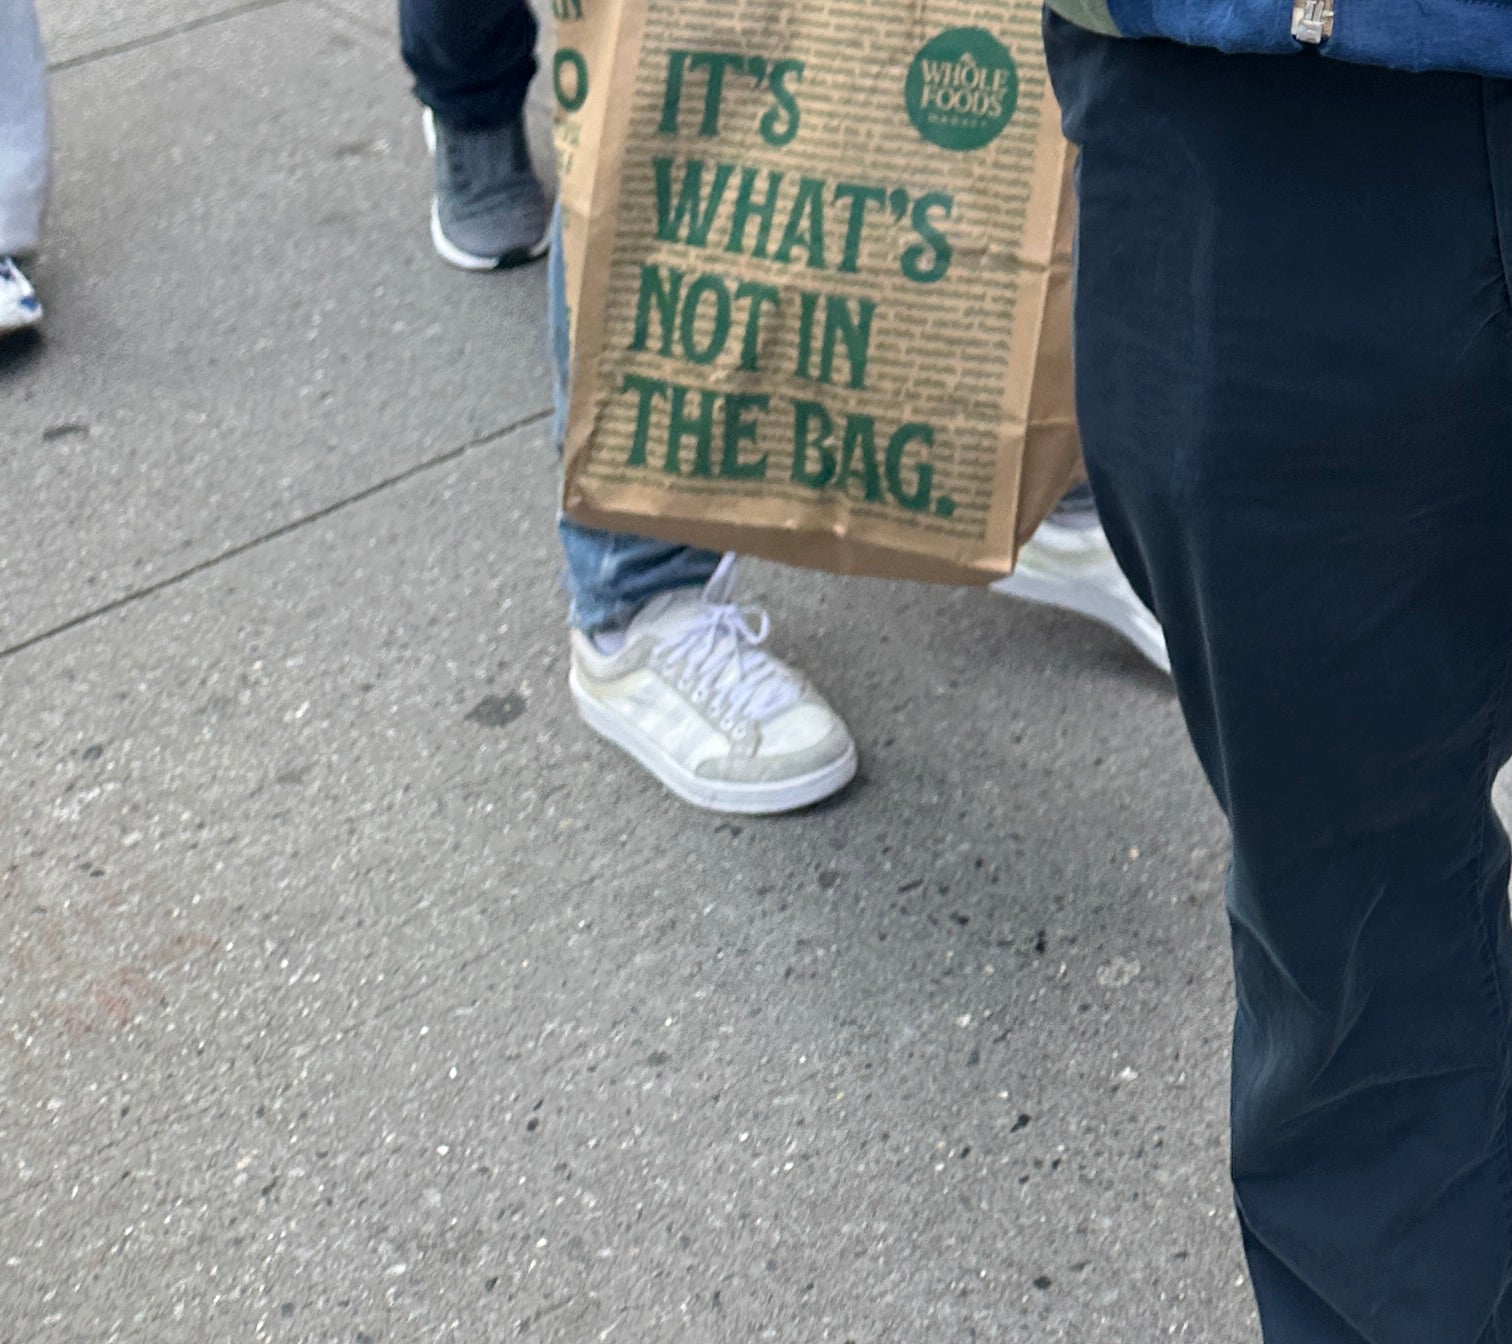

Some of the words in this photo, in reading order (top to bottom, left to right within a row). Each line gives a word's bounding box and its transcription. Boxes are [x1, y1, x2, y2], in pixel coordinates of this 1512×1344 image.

[656, 48, 805, 147] IT'S
[920, 84, 1003, 118] FOODS
[921, 58, 1008, 92] WHOLE
[651, 157, 954, 283] WHAT'S
[626, 263, 780, 372] NOT
[791, 291, 877, 391] IN
[622, 372, 771, 481] THE
[790, 399, 957, 518] BAG.
